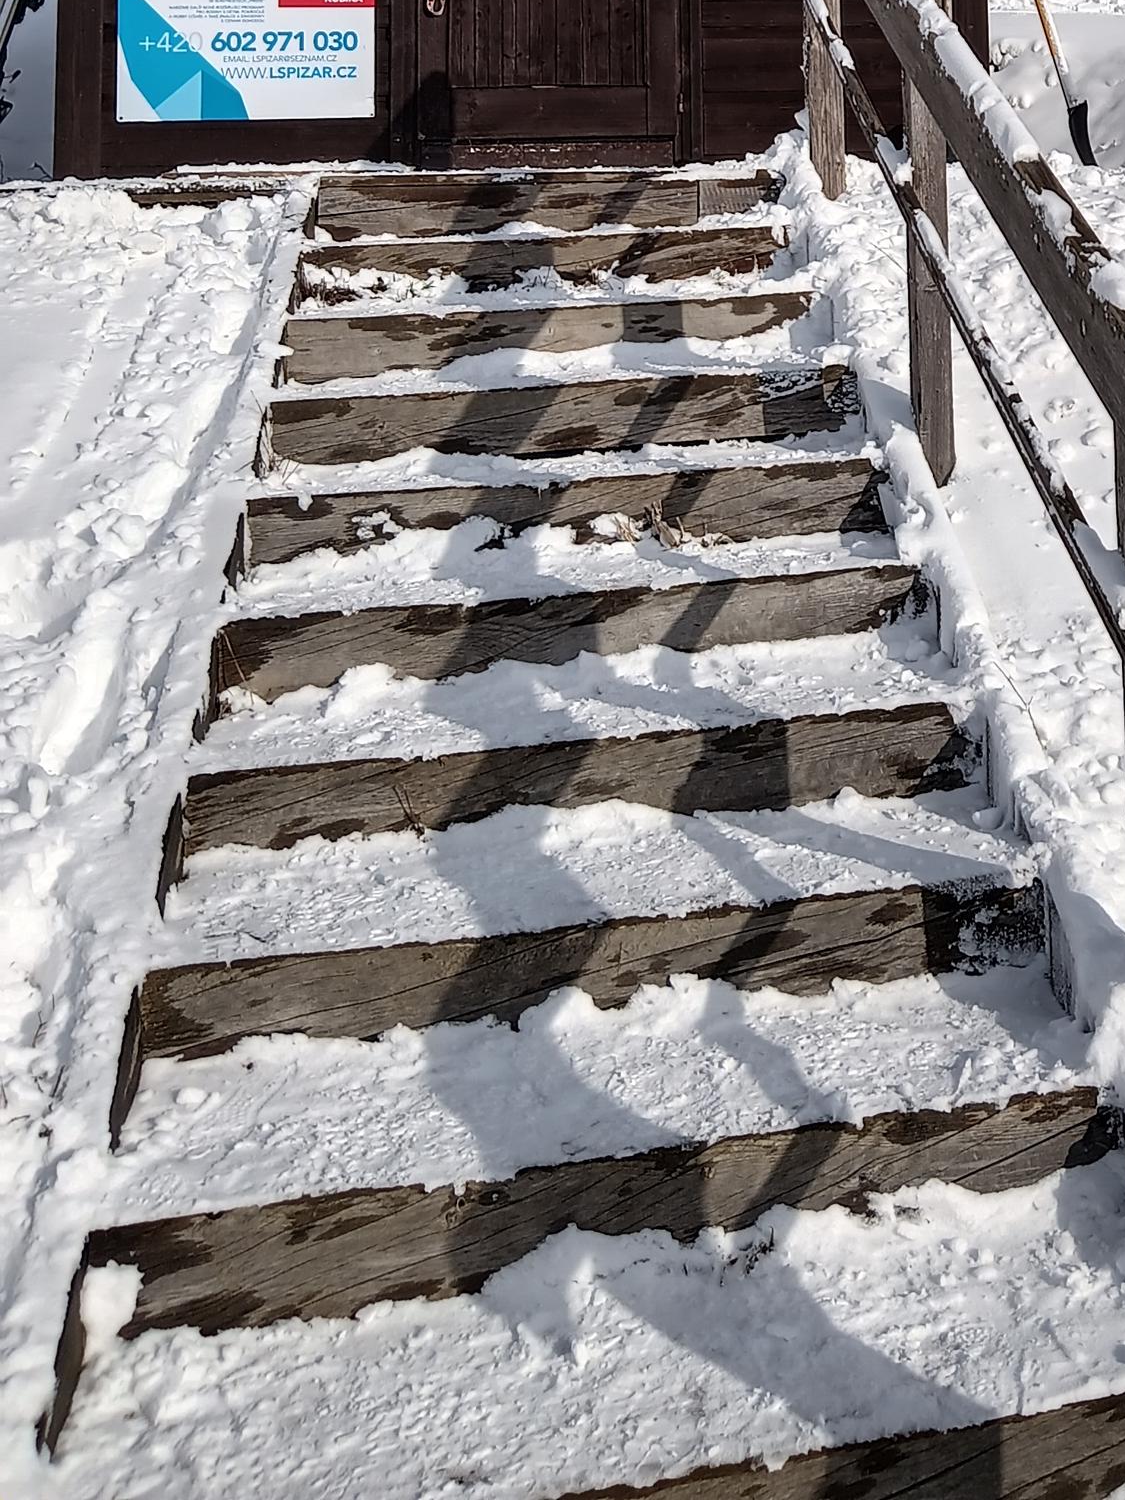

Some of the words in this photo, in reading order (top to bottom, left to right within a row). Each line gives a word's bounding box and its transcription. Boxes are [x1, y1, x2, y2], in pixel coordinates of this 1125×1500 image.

[139, 31, 203, 52] +420
[211, 31, 257, 52] 602
[262, 31, 305, 52] 971
[313, 31, 359, 52] 030
[252, 54, 337, 63] LSPIZAR@SEZNAM.CZ
[221, 66, 358, 79] WWW.LSPIZAR.CZ
